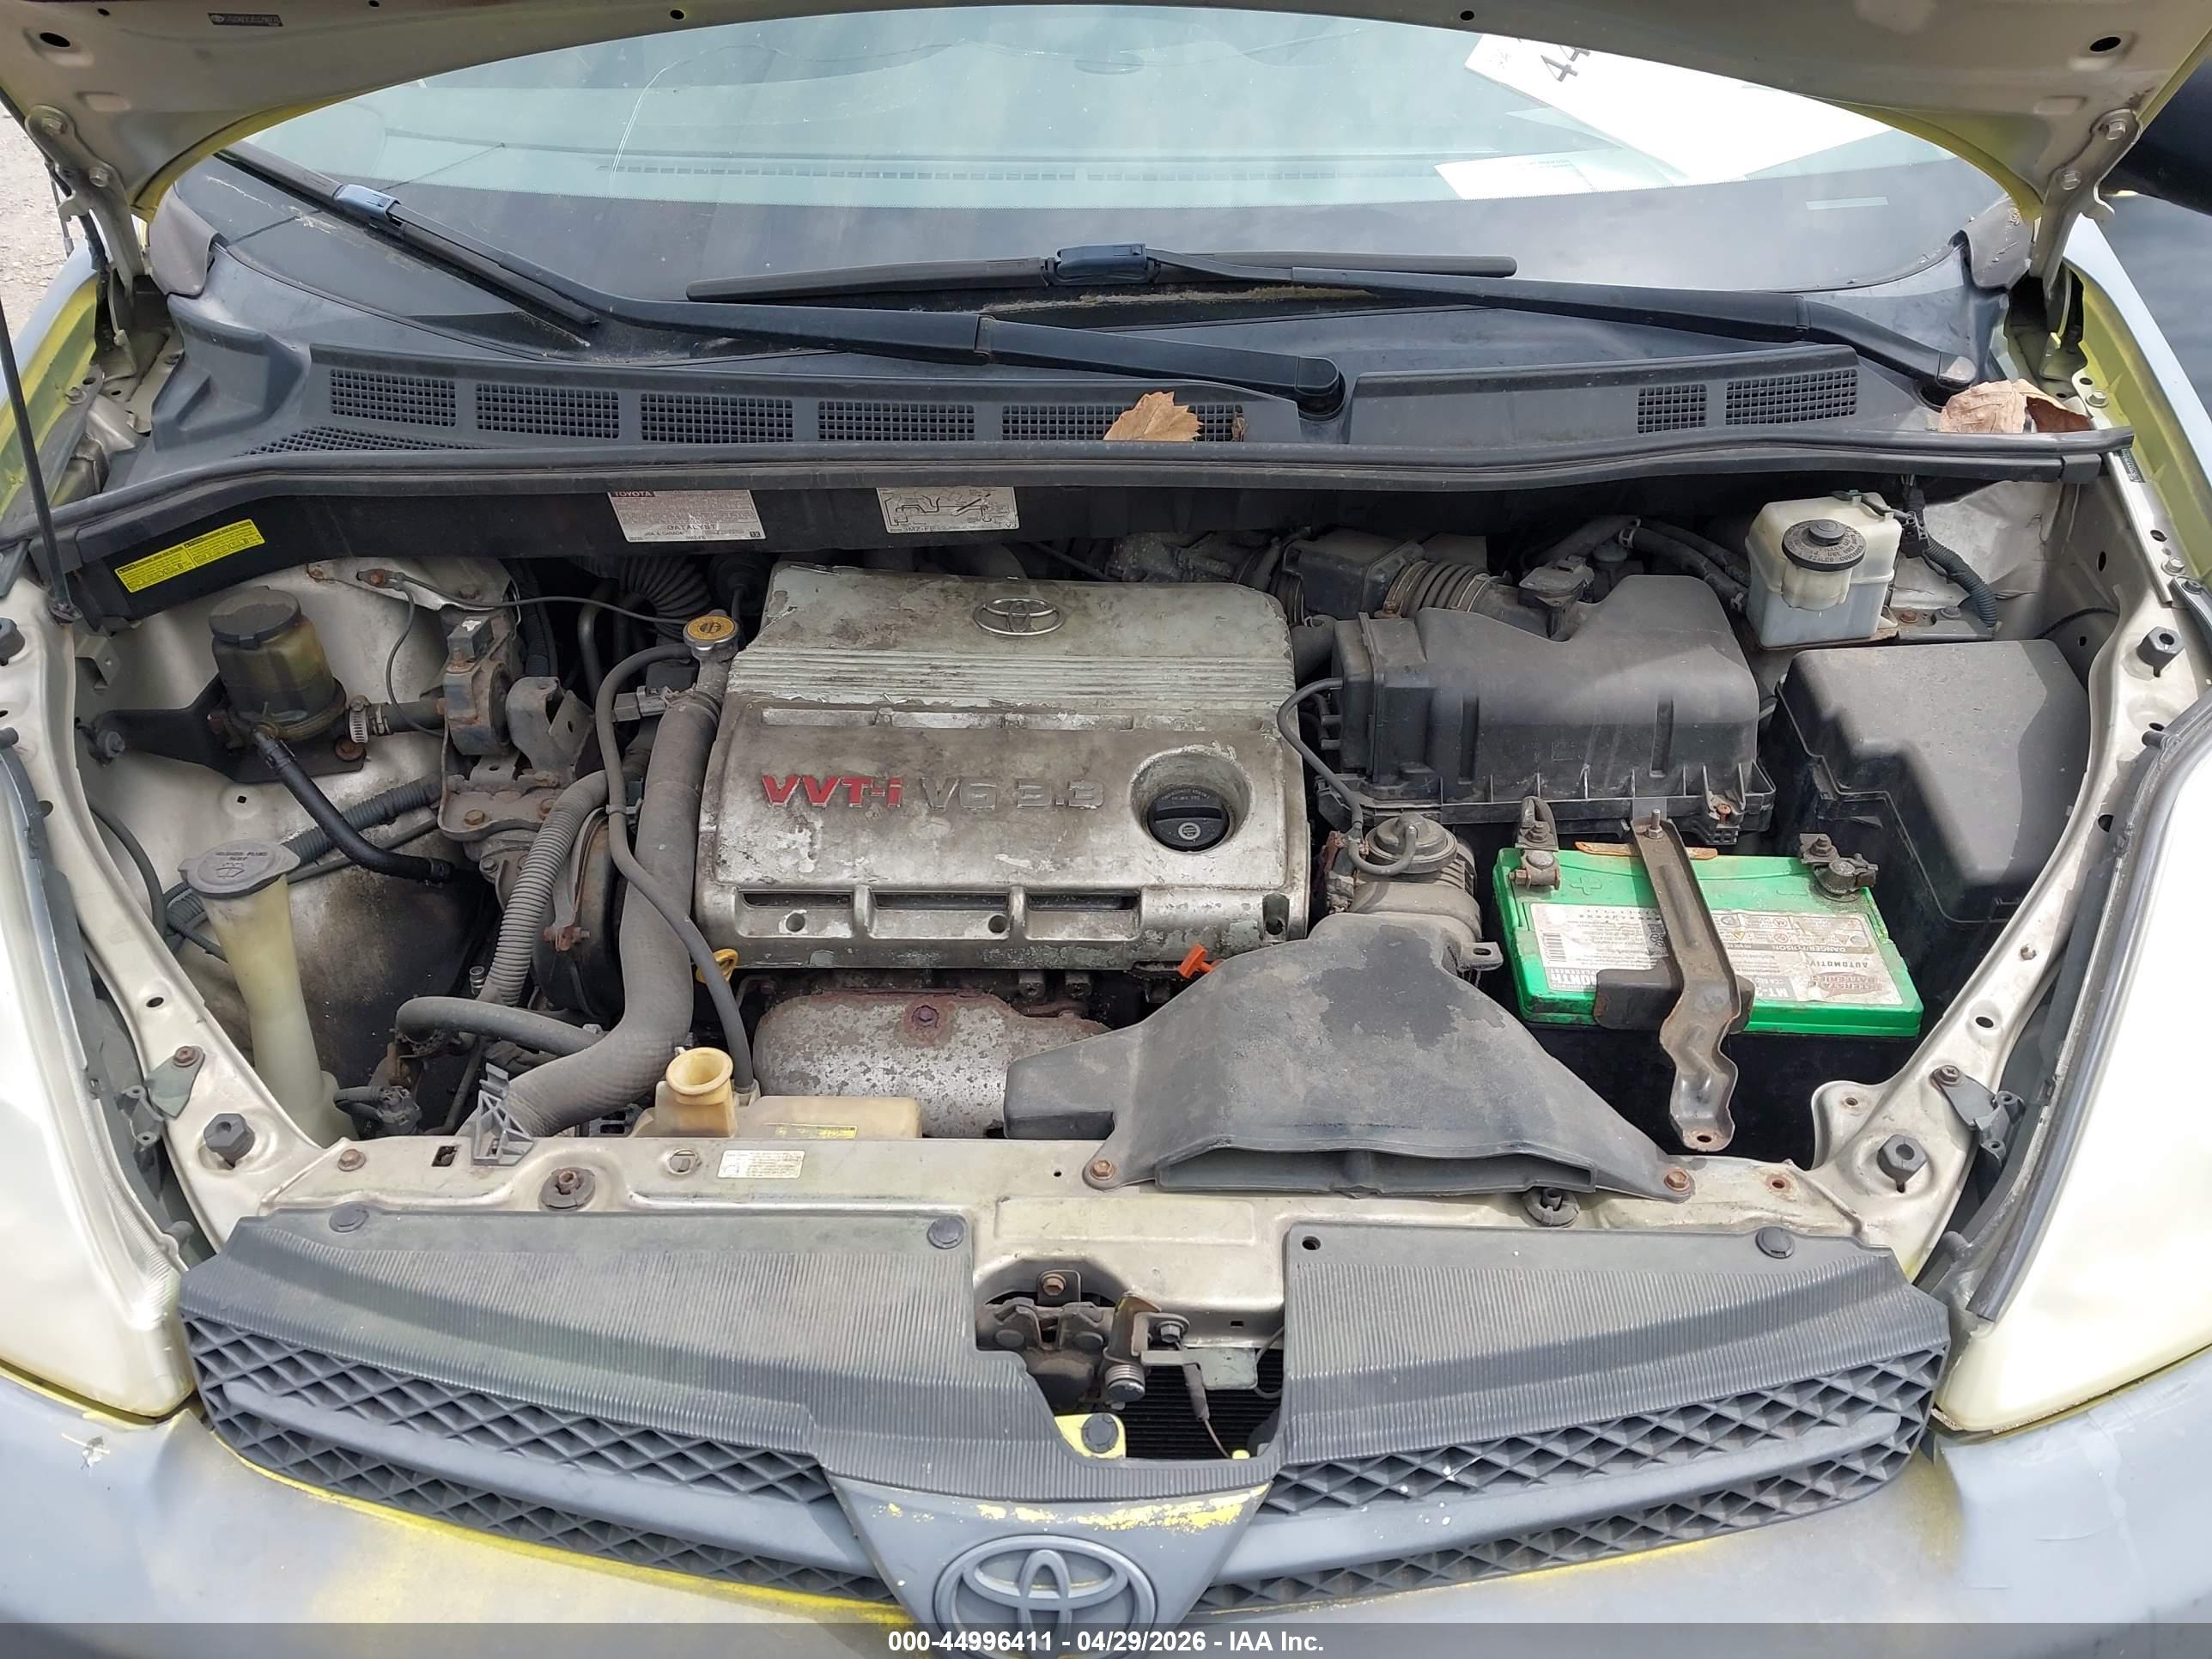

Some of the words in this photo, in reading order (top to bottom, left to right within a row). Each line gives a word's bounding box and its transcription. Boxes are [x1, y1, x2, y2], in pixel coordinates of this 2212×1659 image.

[762, 775, 902, 809] VVT-i
[920, 777, 998, 811] V6
[1016, 777, 1105, 811] 3.3
